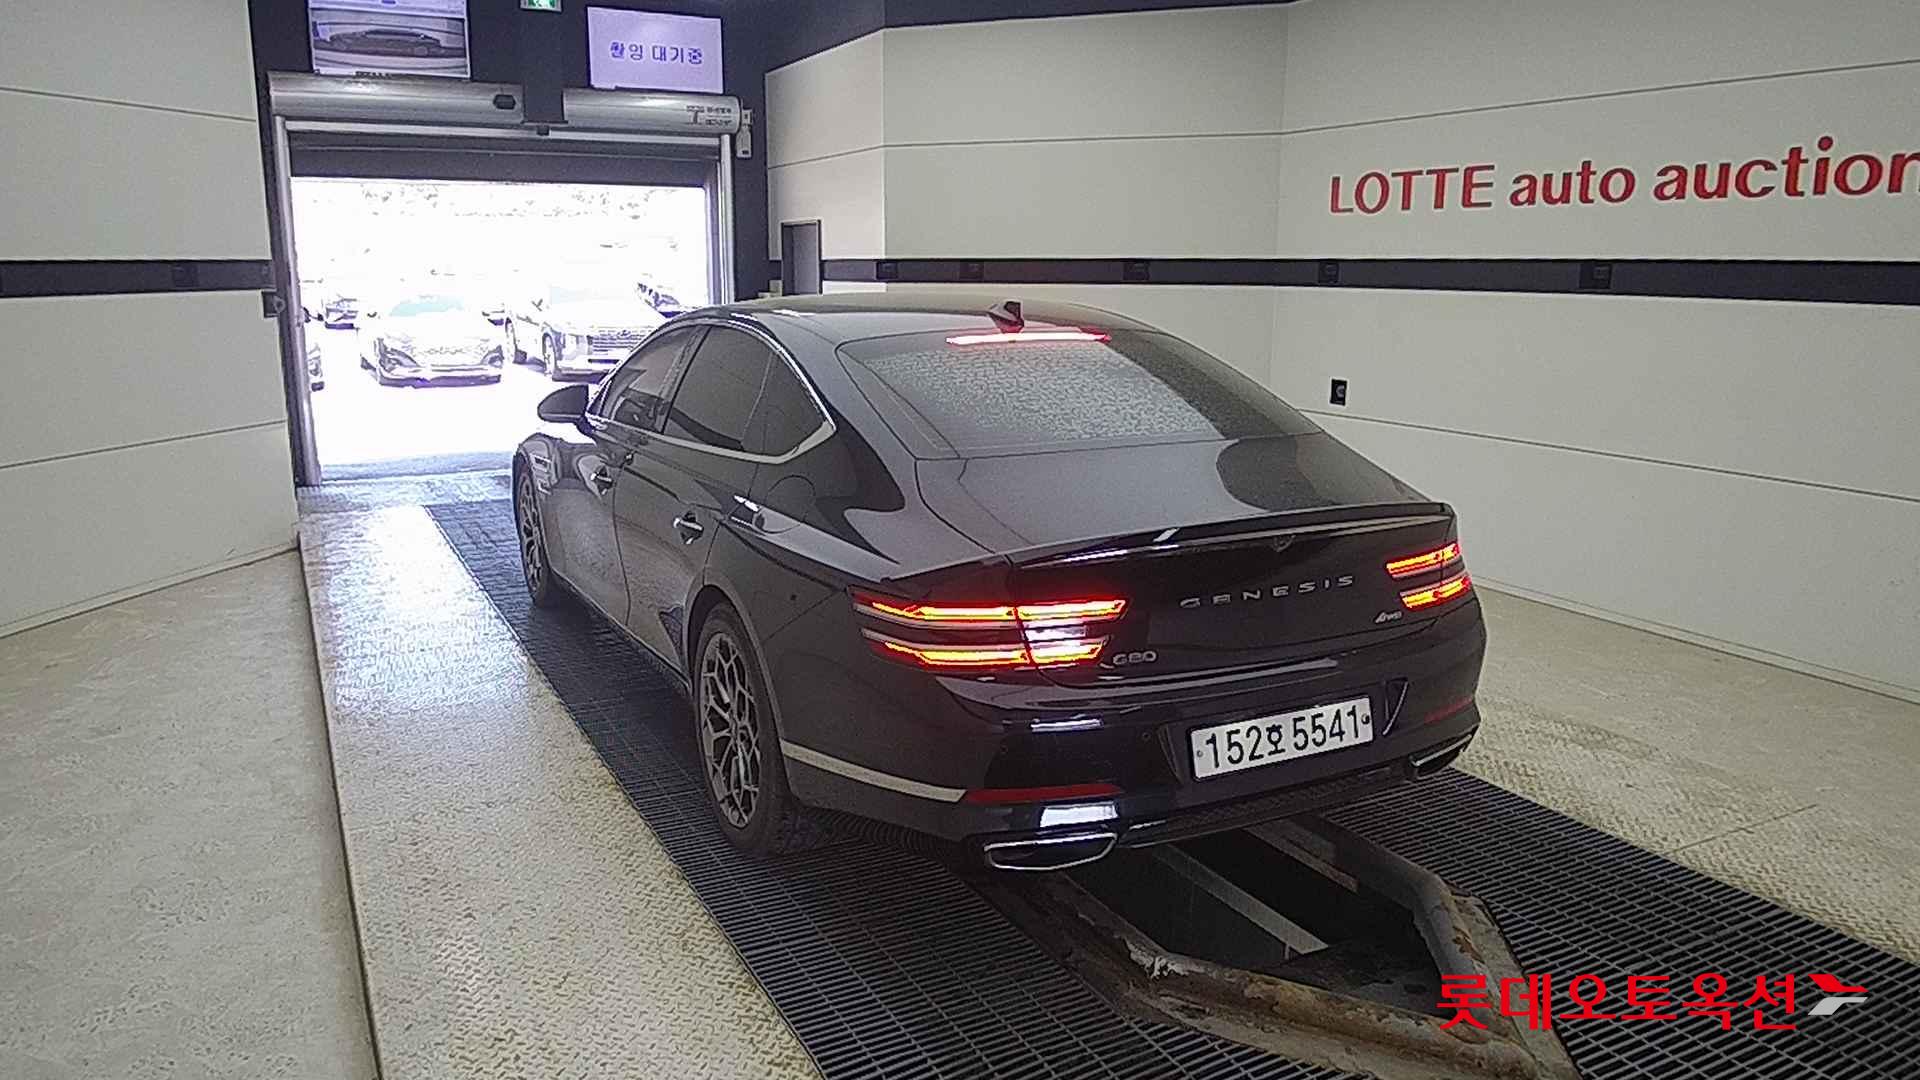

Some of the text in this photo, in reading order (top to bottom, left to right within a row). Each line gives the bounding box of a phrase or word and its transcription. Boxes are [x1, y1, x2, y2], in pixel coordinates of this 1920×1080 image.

[1330, 163, 1495, 214] LOTTE
[1510, 160, 1636, 207] auto
[1180, 575, 1353, 608] GENESIS
